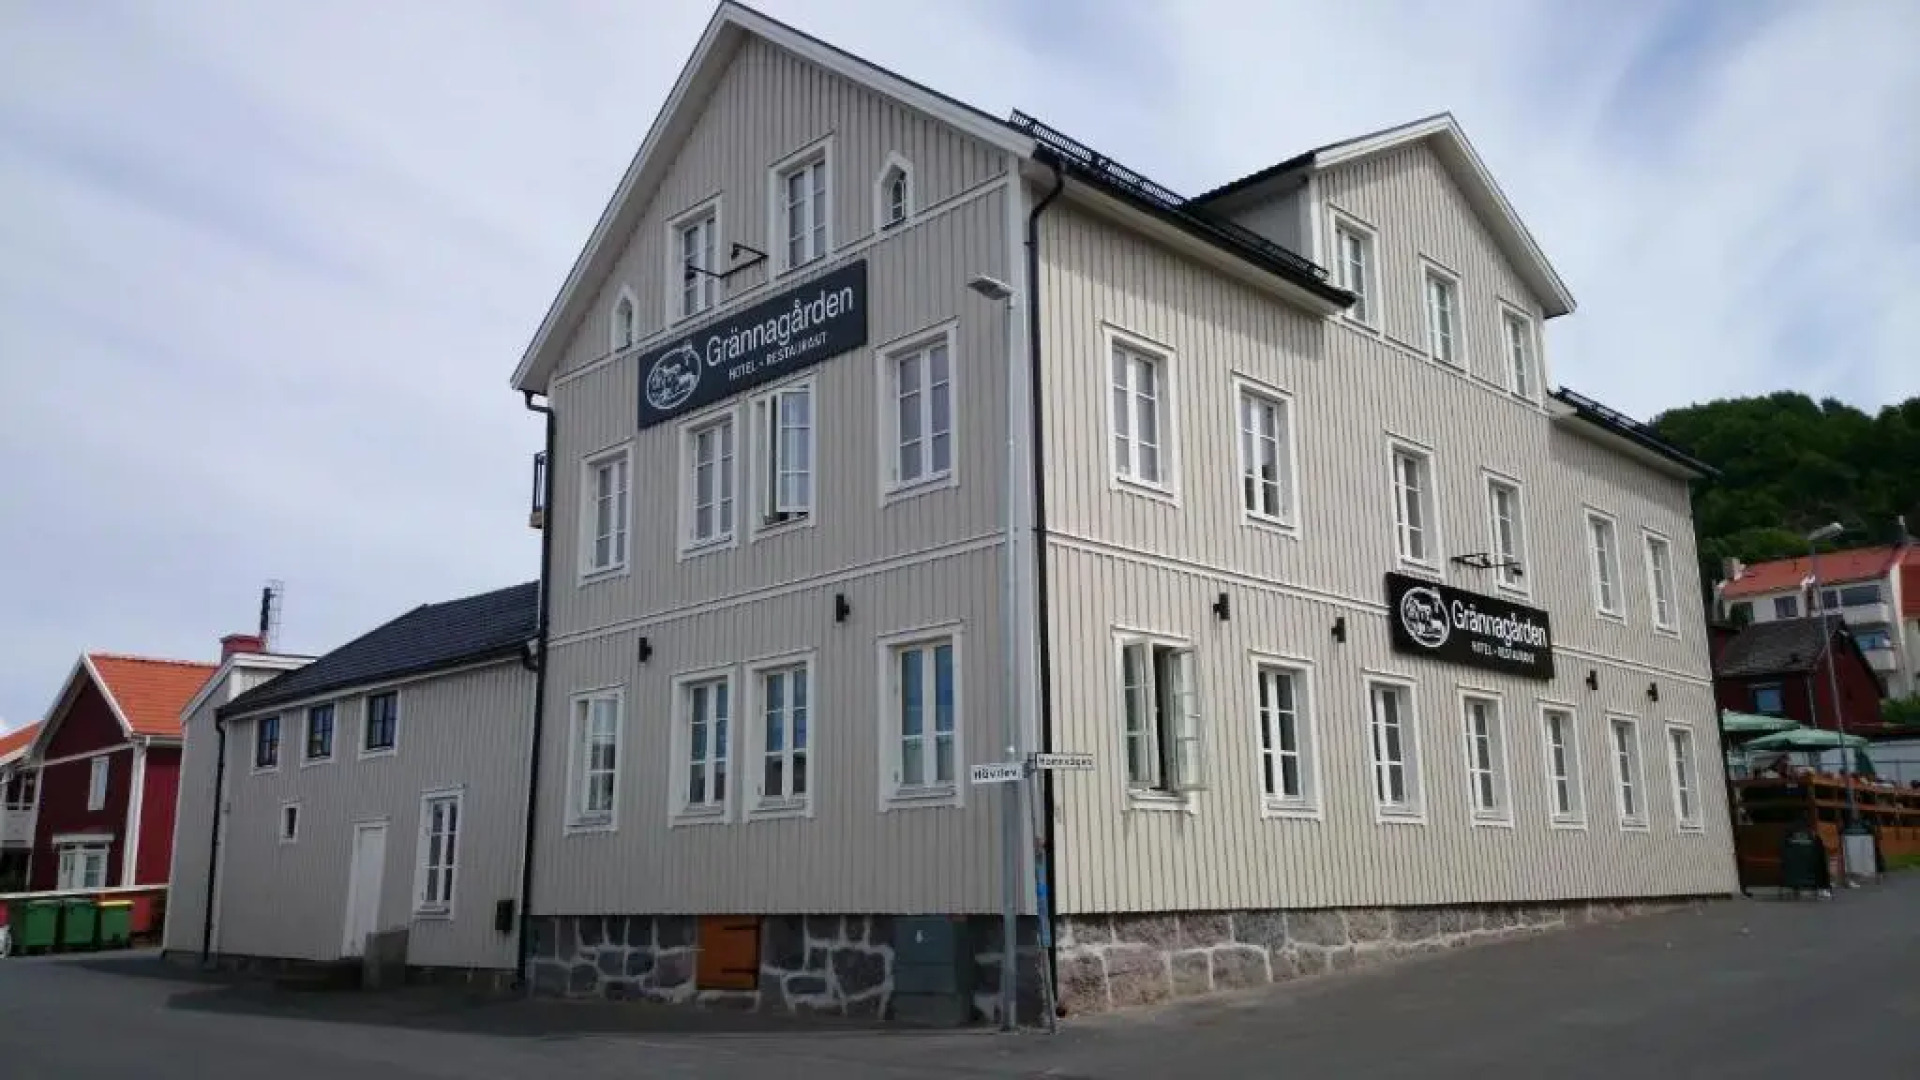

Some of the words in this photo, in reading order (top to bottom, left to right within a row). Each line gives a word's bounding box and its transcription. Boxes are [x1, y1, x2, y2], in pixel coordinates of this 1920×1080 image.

[706, 286, 853, 367] Grännagården
[729, 362, 756, 382] HOTEL
[767, 332, 827, 366] RESTAURANT
[1452, 600, 1547, 648] Grännagården
